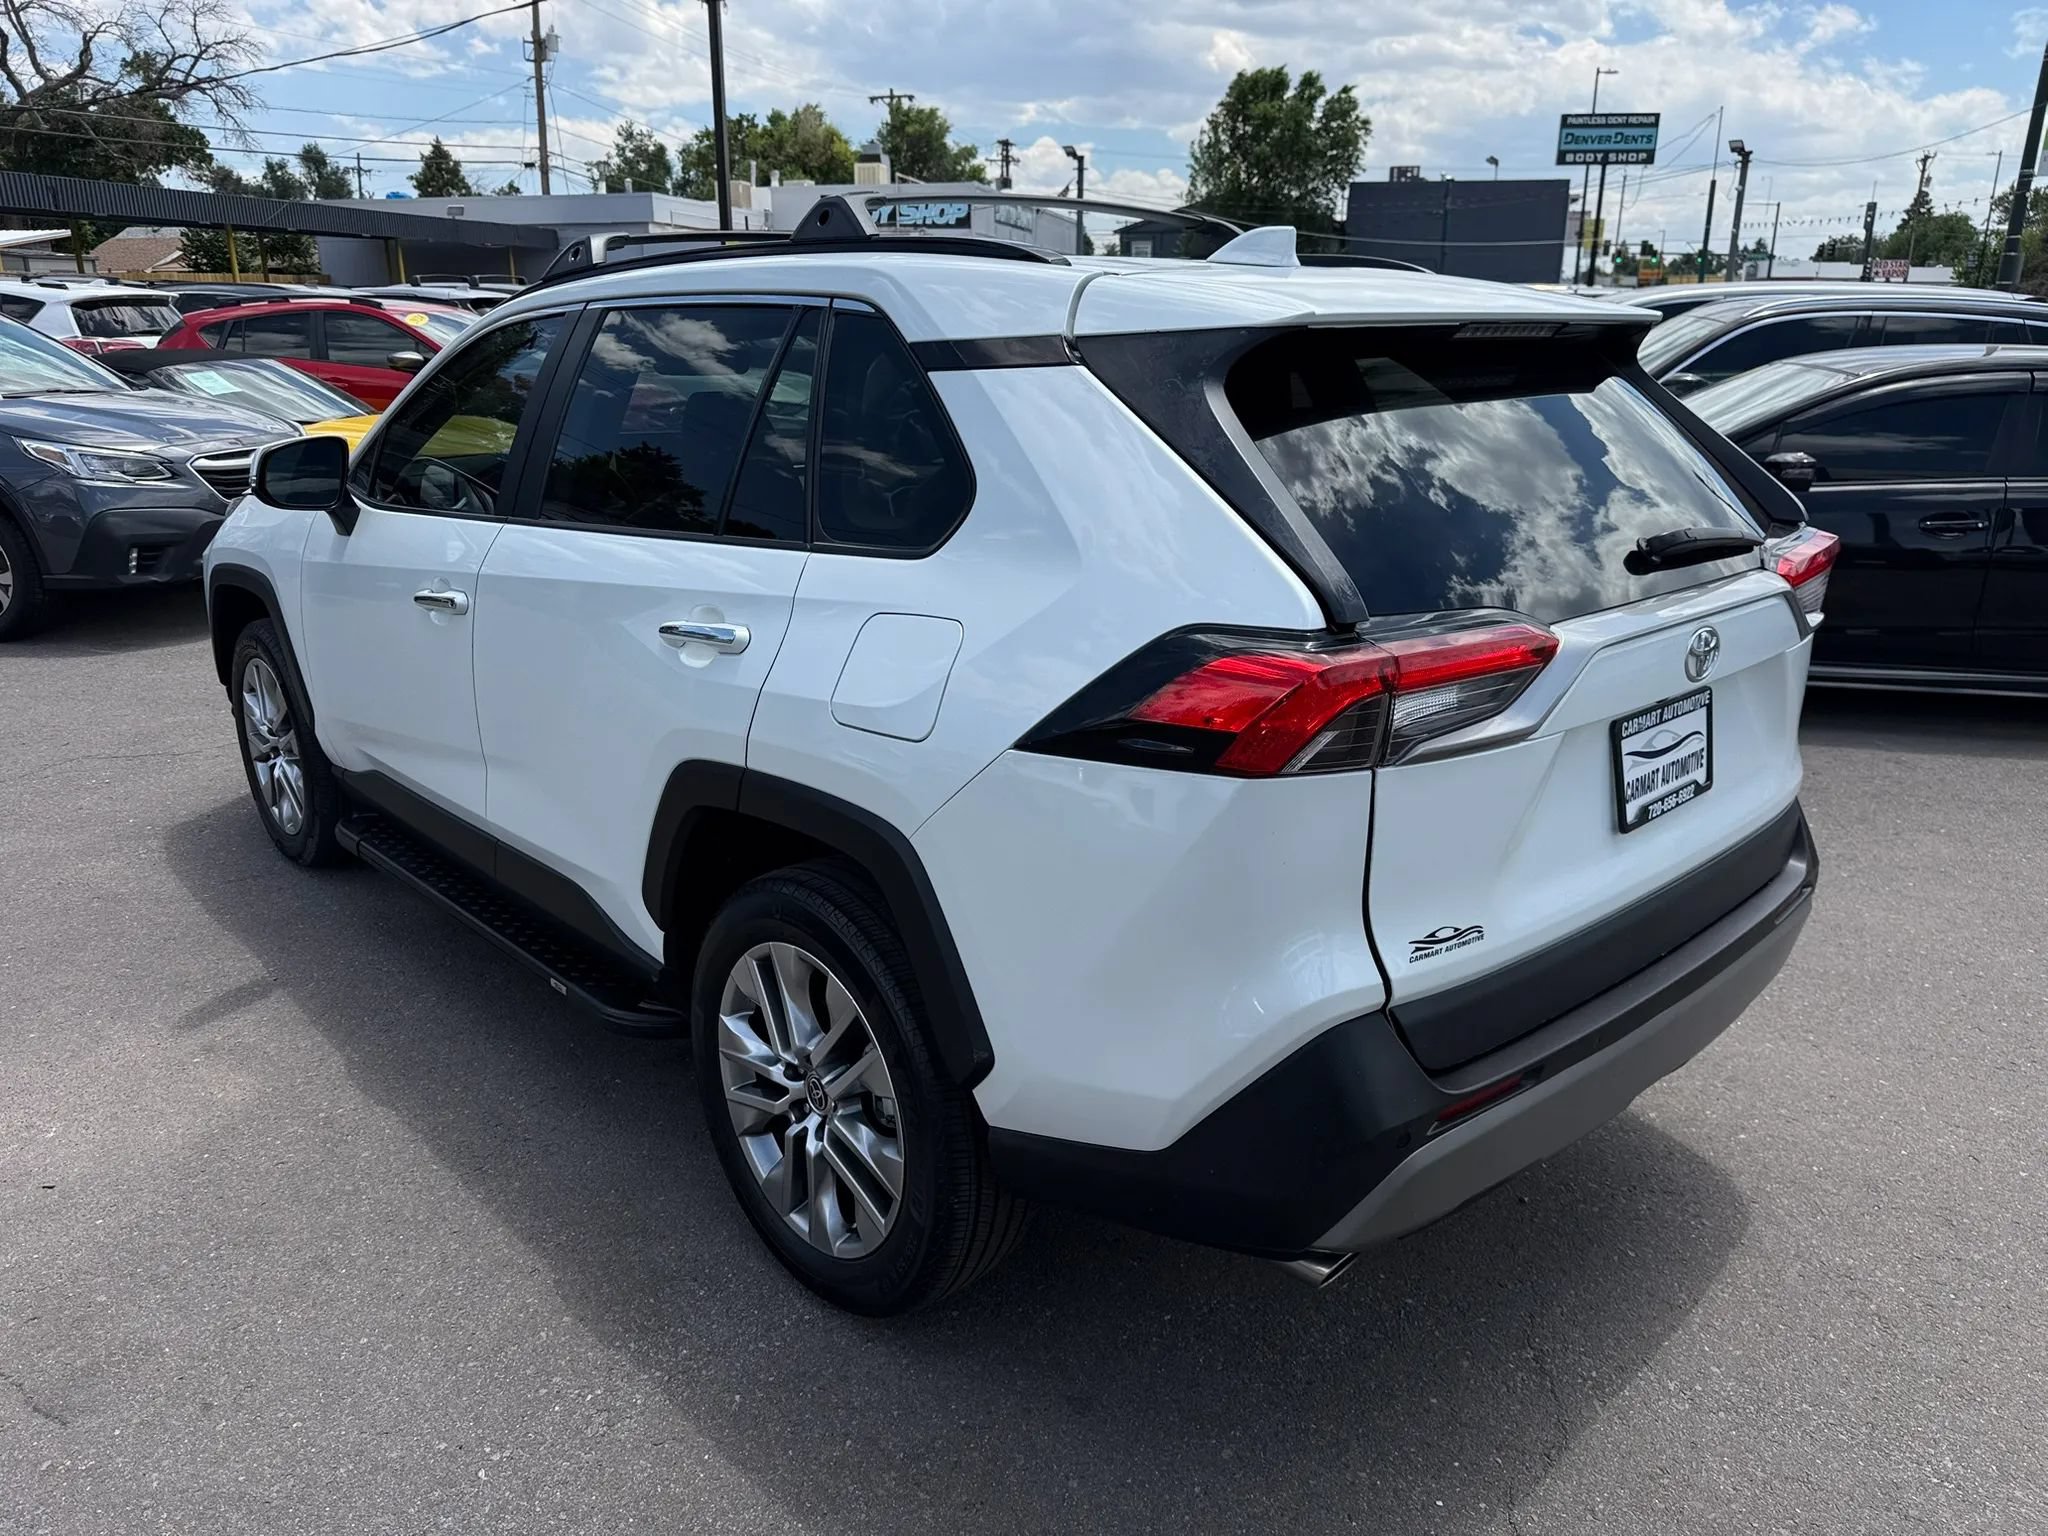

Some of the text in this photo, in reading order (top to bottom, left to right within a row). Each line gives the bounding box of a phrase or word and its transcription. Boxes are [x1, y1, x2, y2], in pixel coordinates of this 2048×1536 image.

[1565, 152, 1648, 162] BODY SHOP
[899, 203, 970, 225] SHOP
[1621, 689, 1711, 738] CARMART AUTOMOTIVE
[1625, 747, 1705, 804] CARMART AUTOMOTIVE
[1409, 933, 1485, 964] CARMART AUTOMOTIVE
